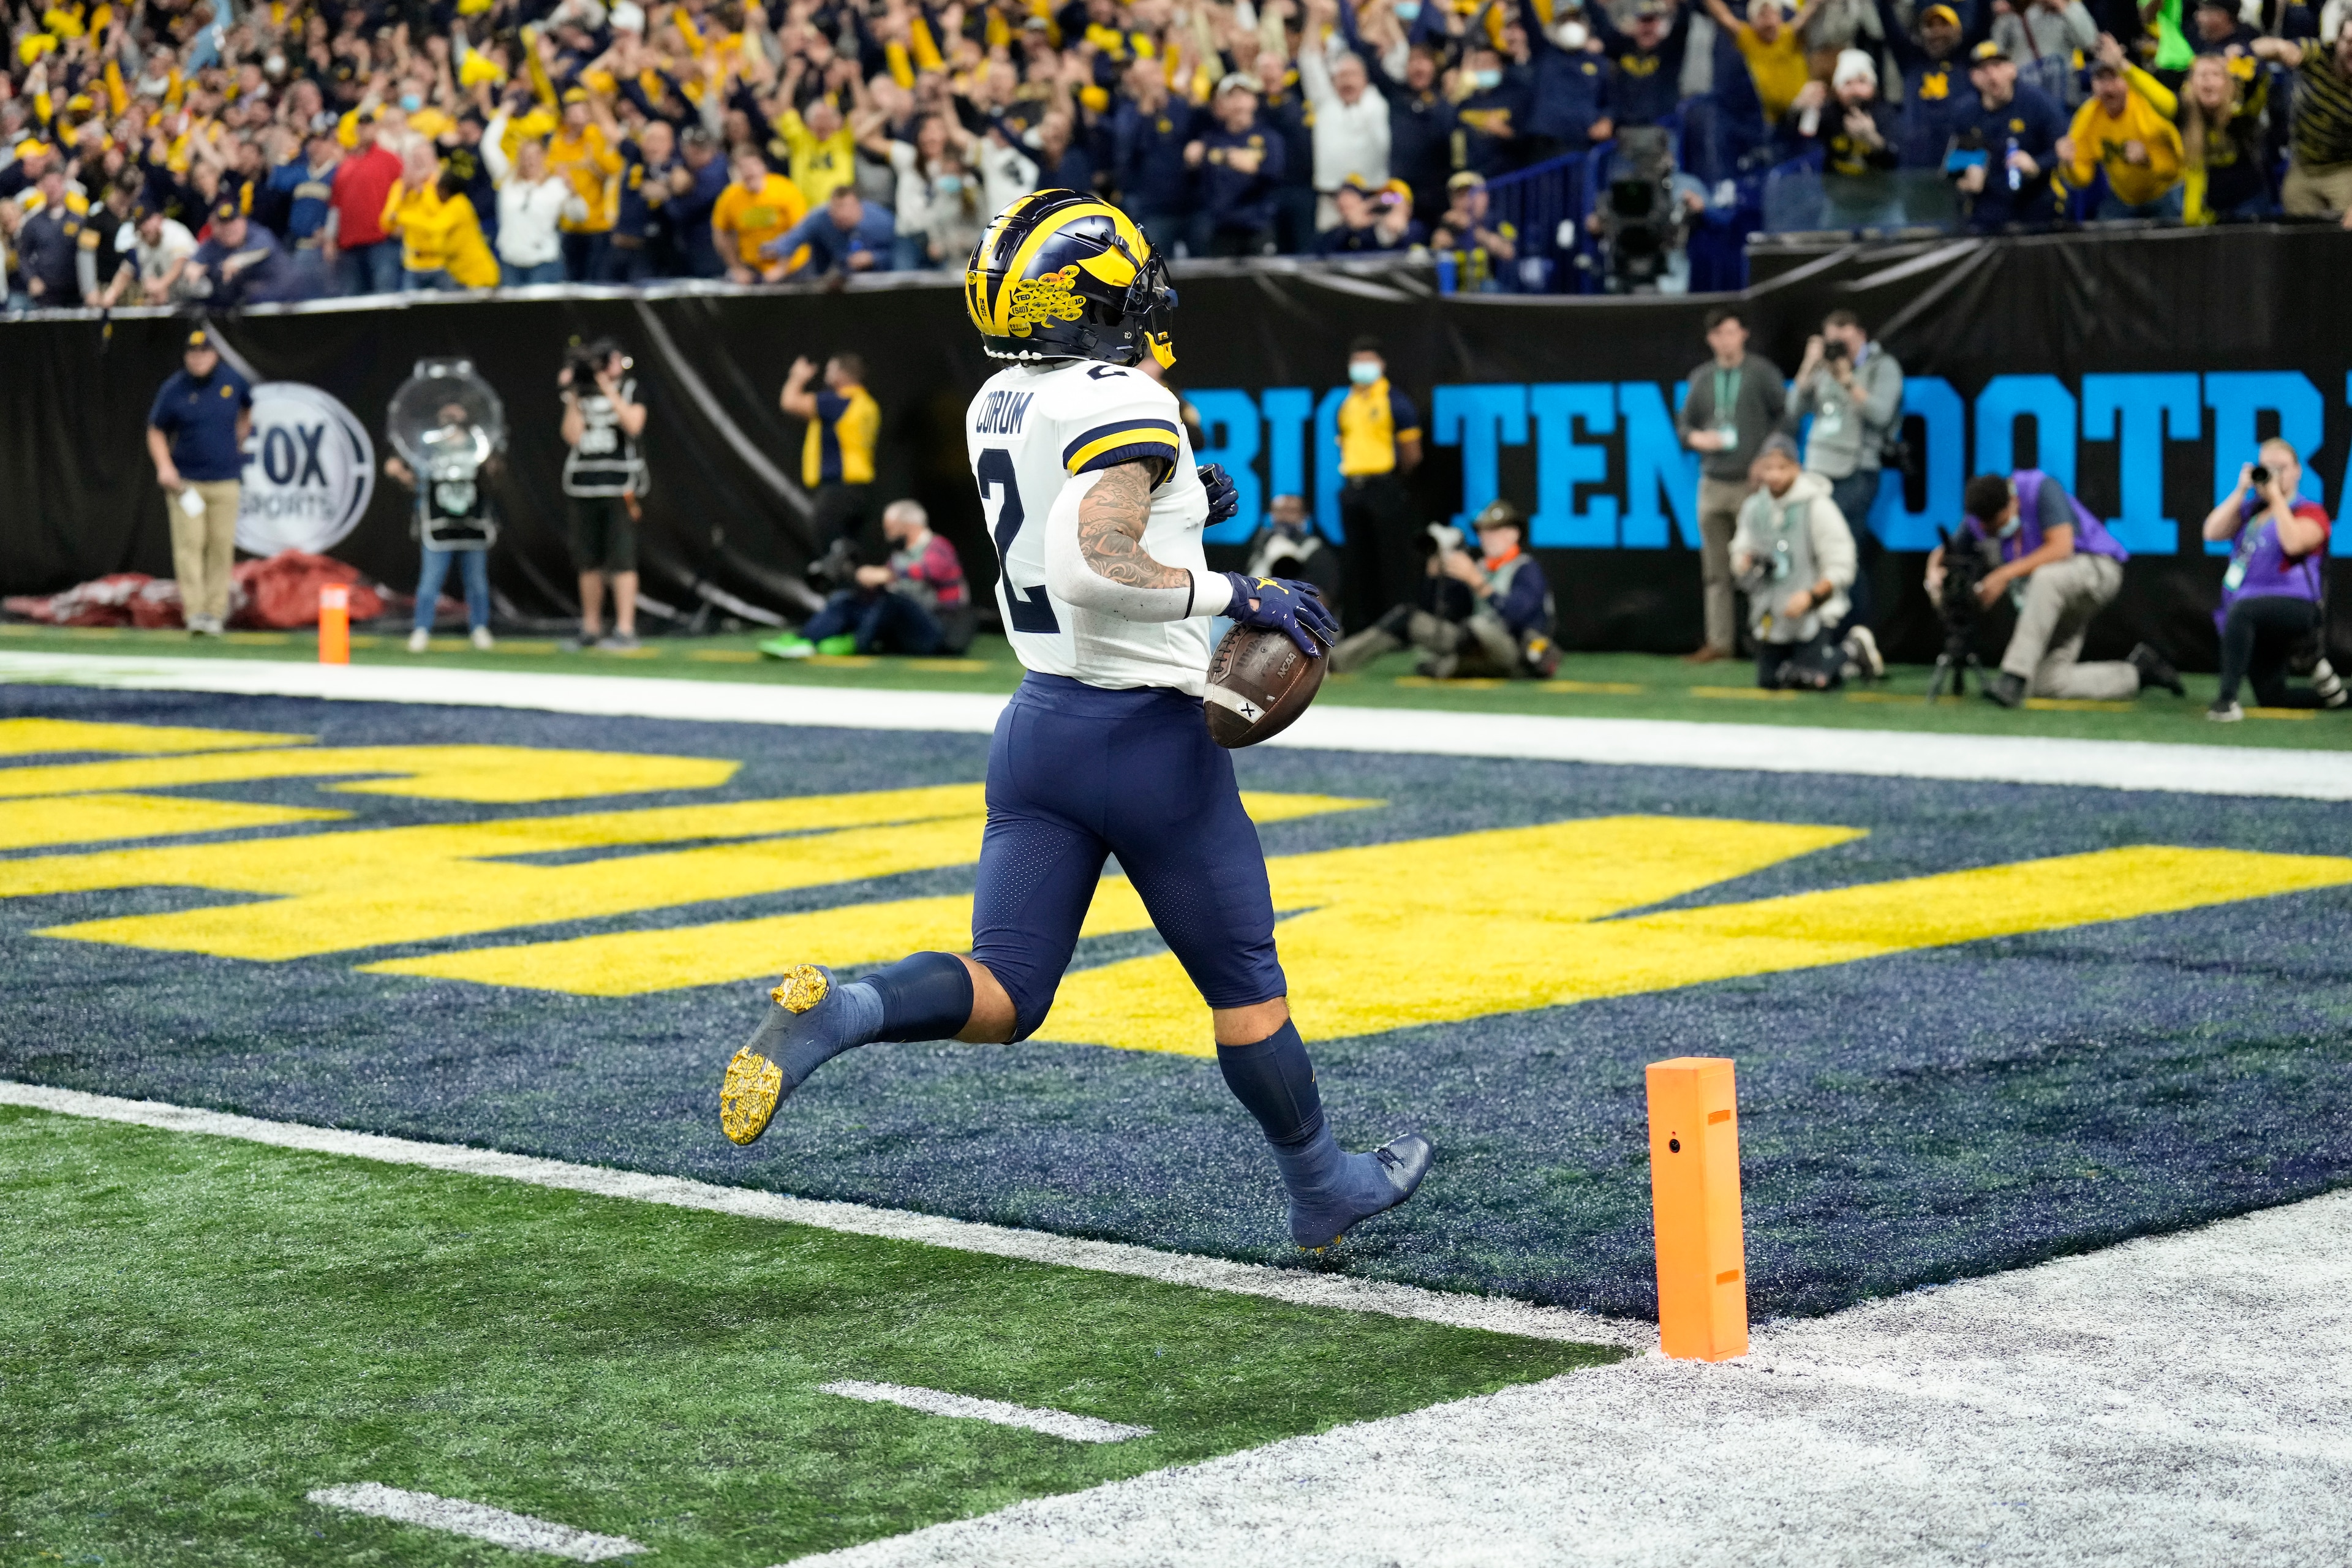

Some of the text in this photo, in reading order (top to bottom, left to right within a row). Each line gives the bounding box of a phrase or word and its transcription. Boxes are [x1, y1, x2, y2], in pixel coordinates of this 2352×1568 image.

[1012, 306, 1028, 314] (540)
[976, 390, 1035, 434] CORUM
[1433, 380, 1702, 550] TEN
[1784, 370, 2352, 560] OOTB
[978, 448, 1061, 634] 2
[1277, 652, 1297, 679] NCAA
